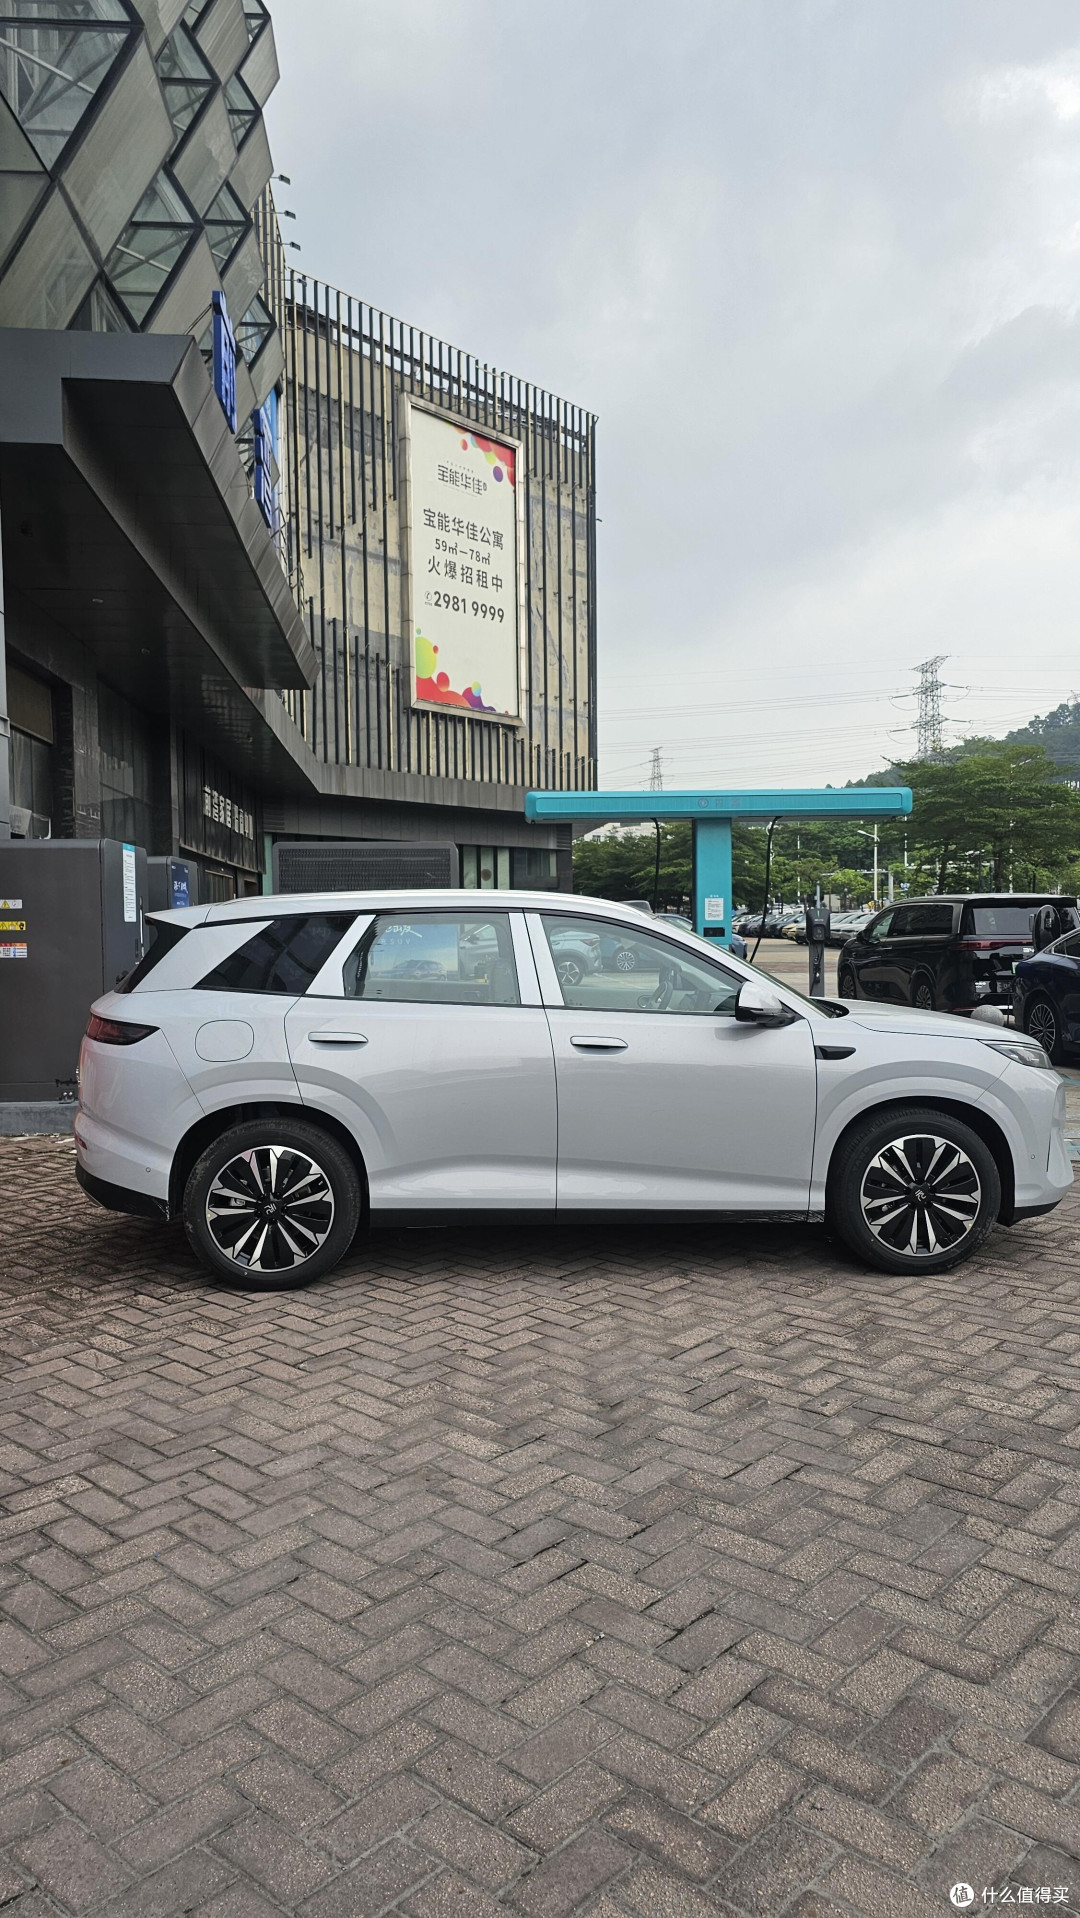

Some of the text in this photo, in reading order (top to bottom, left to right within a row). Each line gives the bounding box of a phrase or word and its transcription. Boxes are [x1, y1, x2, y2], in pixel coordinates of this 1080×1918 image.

[437, 464, 483, 496] 宝能华佳
[423, 508, 504, 550] 宝能华佳公寓
[428, 555, 503, 592] 火爆招租中
[434, 590, 504, 623] 2981 9999
